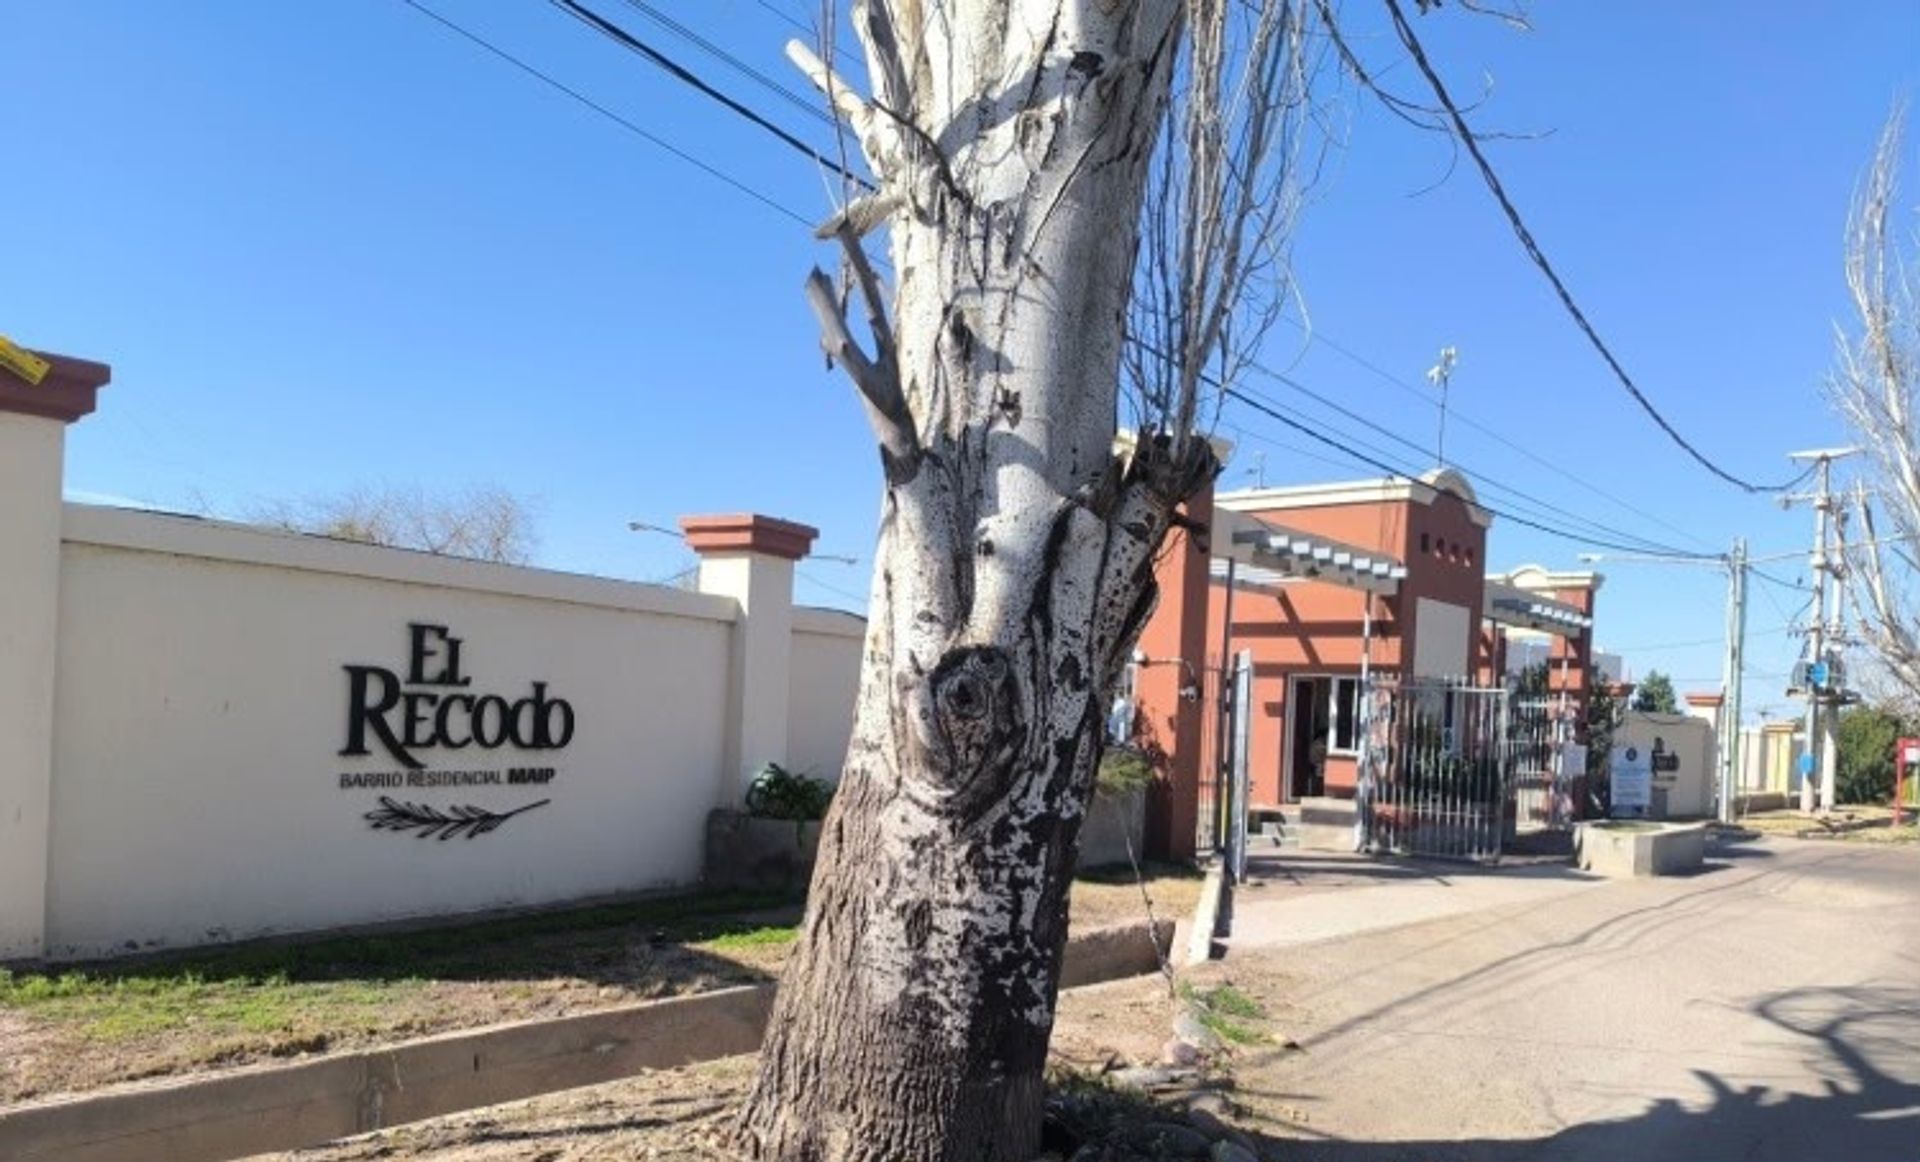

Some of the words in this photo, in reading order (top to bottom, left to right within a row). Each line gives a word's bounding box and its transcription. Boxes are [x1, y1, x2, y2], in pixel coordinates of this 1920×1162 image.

[339, 772, 403, 789] BARRIO
[407, 770, 503, 787] RESIDENCIAL
[507, 767, 556, 785] MAIP
